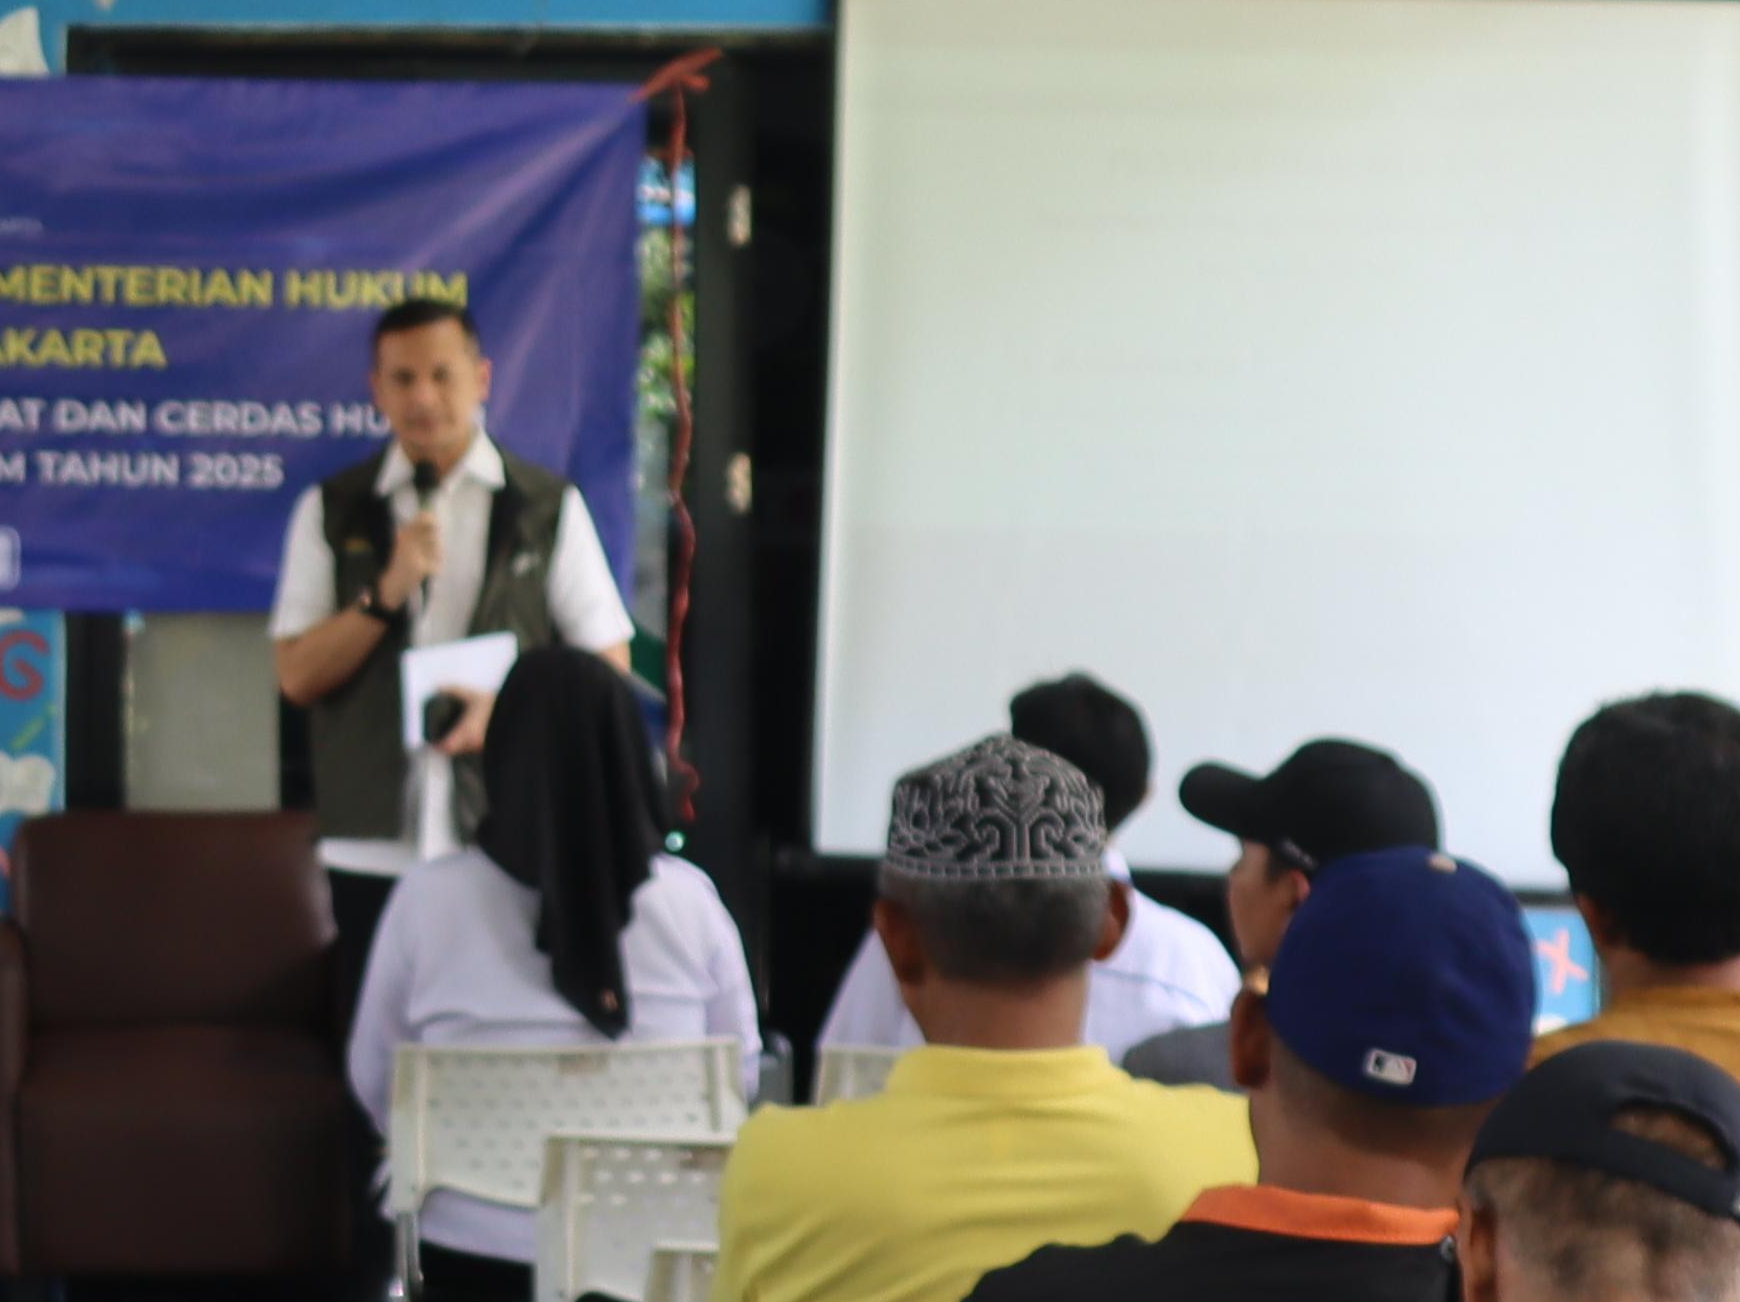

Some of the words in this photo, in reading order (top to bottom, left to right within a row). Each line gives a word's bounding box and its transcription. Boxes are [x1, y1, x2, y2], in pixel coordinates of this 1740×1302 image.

[286, 268, 468, 308] HUKUM
[53, 399, 146, 434] DAN
[154, 402, 323, 437] CERDAS
[37, 452, 180, 487] TAHUN
[189, 454, 284, 488] 2025
